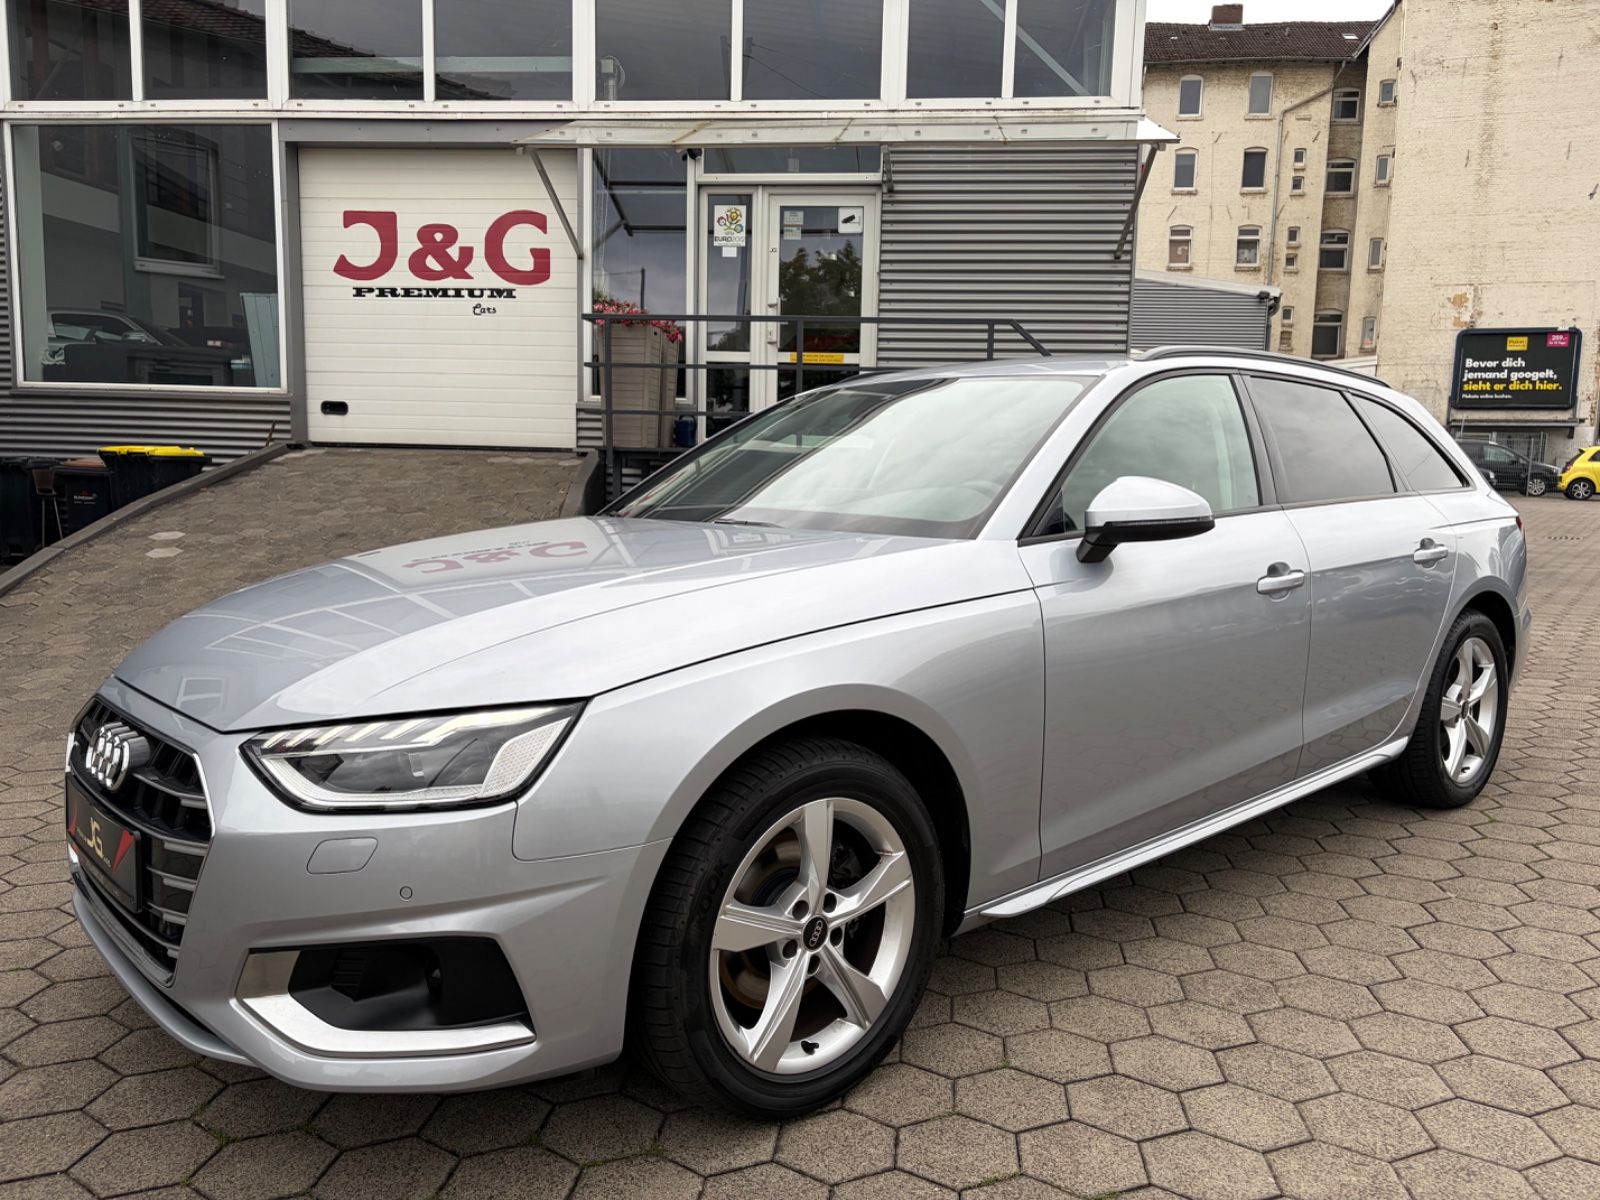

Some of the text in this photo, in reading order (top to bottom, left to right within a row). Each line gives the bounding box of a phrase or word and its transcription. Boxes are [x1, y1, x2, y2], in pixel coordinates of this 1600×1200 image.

[333, 209, 551, 286] J&G
[352, 287, 517, 299] PREMIUM
[472, 303, 497, 316] Cars
[1465, 357, 1526, 368] Bevor dich
[1463, 369, 1557, 381] jemand googelt,
[1463, 380, 1562, 391] sieht er dich hier.
